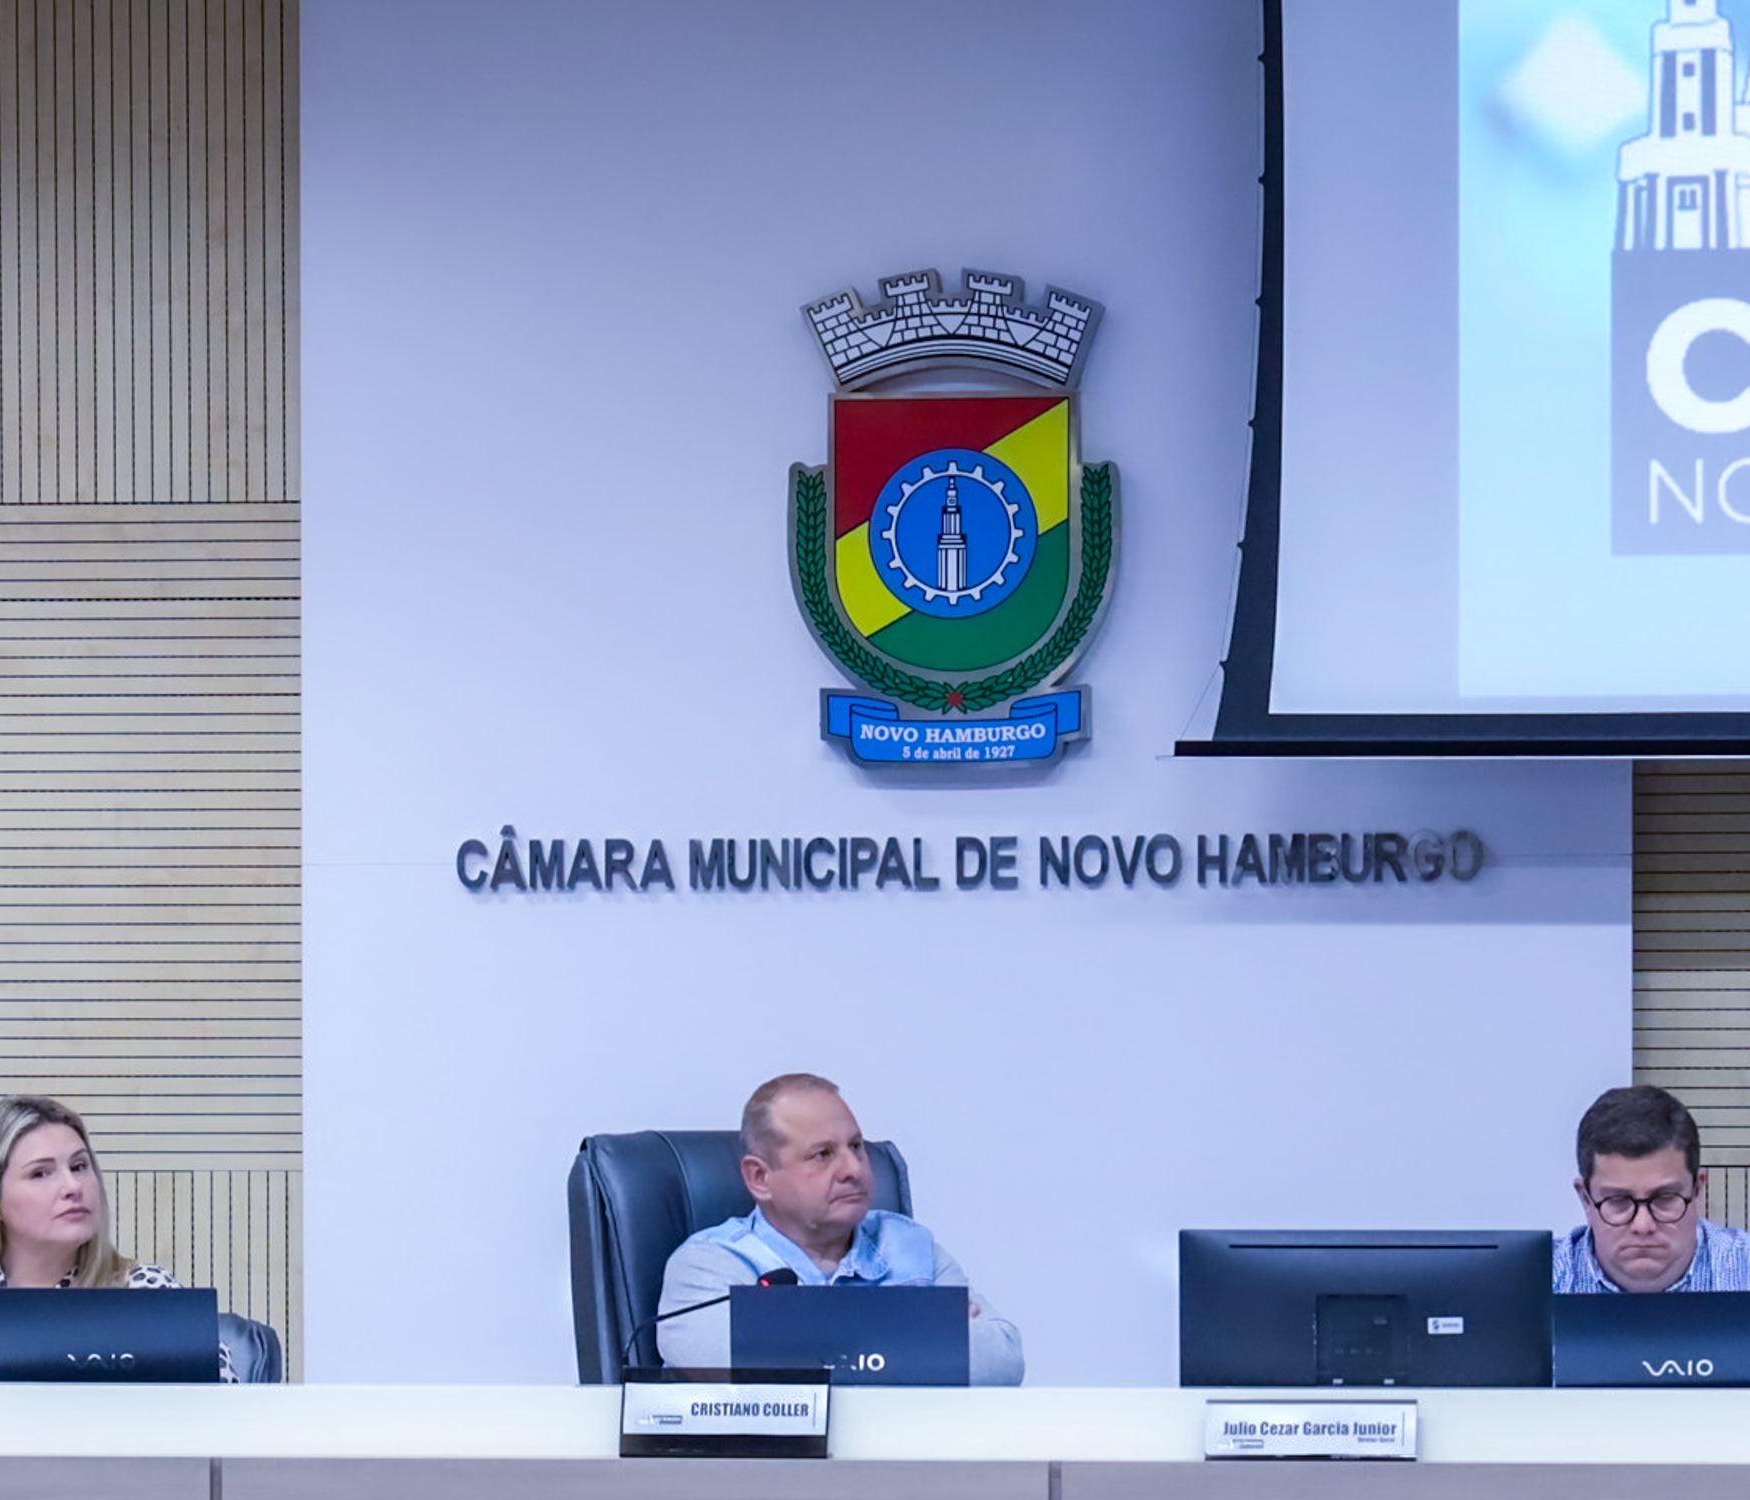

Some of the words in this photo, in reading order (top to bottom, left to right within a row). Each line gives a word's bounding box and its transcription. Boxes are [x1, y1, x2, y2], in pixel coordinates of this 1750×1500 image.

[860, 724, 918, 742] NOVO
[925, 723, 1046, 743] HAMBURGO
[902, 746, 911, 759] 5
[914, 746, 929, 759] de
[933, 746, 961, 760] abril
[965, 746, 980, 760] de
[985, 745, 1016, 759] 1927
[456, 824, 676, 891] CÂMARA
[688, 836, 941, 891] MUNICIPAL
[955, 835, 1019, 890] DE
[1039, 833, 1183, 888] NOVO
[1197, 830, 1485, 886] HAMBURGO
[1642, 1359, 1714, 1376] VAIO
[691, 1402, 760, 1417] CRISTIANO
[763, 1402, 809, 1417] COLLER
[1223, 1421, 1257, 1436] Julio
[1260, 1421, 1300, 1436] Cezar
[1302, 1421, 1349, 1436] Garcia
[1353, 1421, 1397, 1436] Junior
